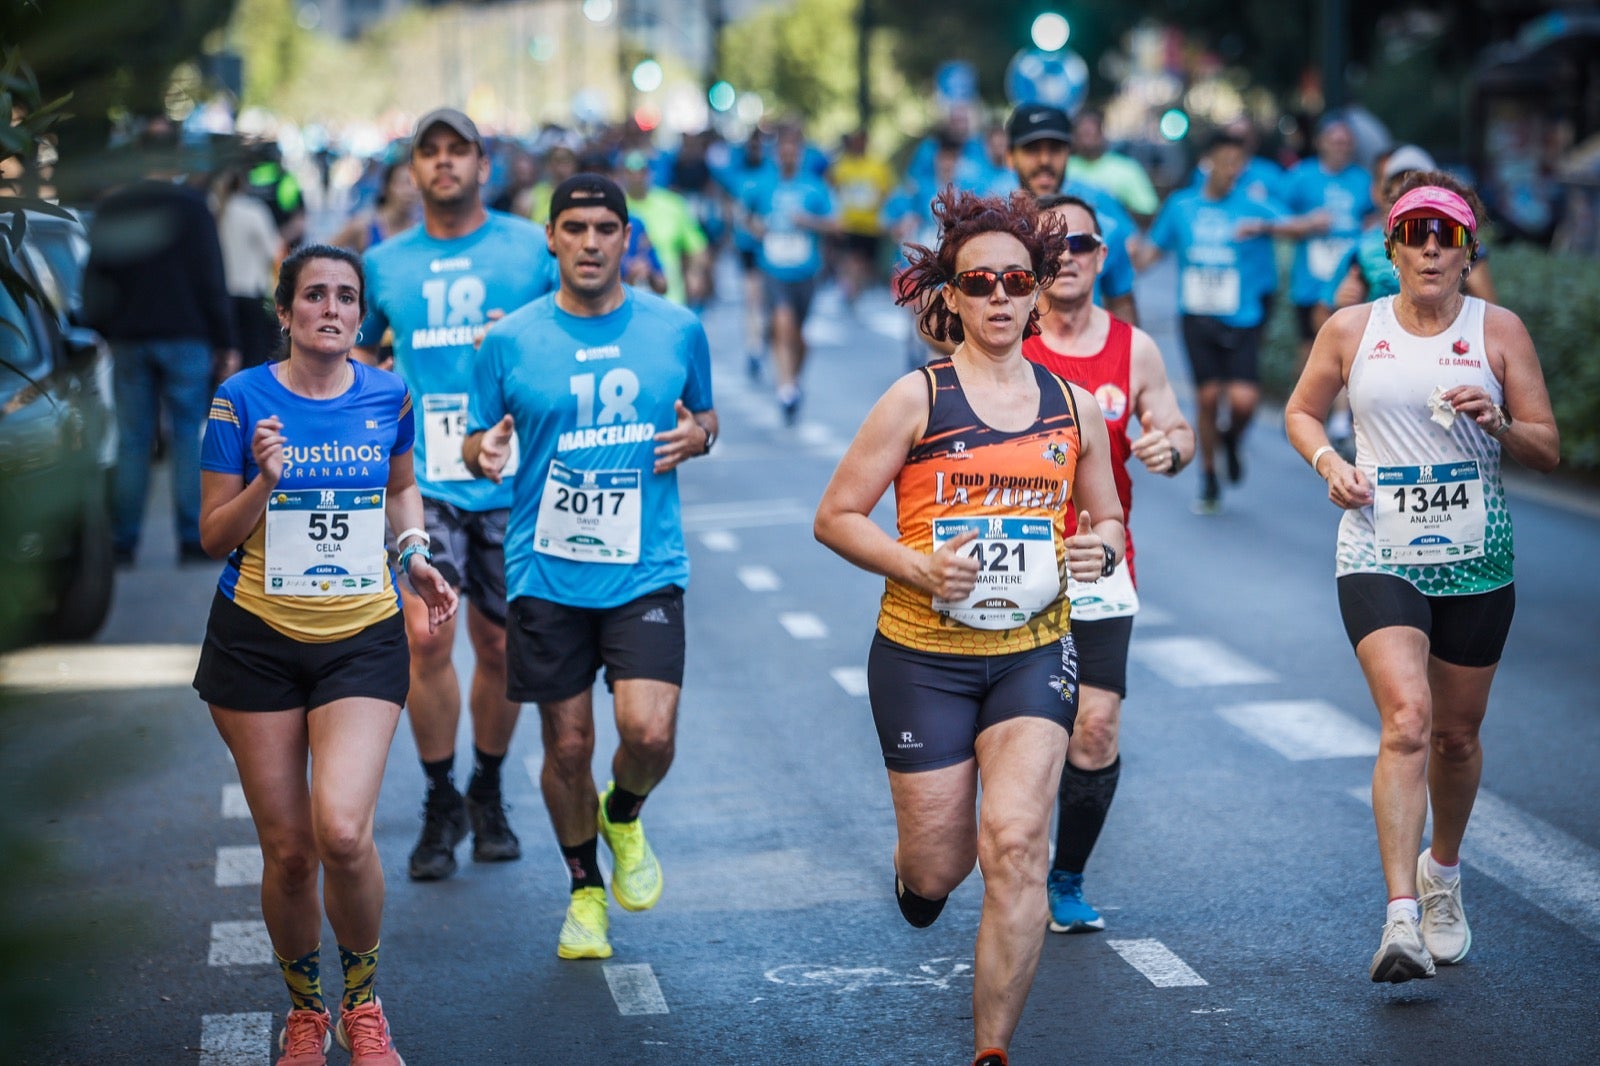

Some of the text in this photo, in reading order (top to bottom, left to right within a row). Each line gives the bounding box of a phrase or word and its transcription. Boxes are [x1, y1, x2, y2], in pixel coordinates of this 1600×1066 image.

[422, 276, 486, 327] 18
[1452, 359, 1481, 369] GARNATA
[570, 367, 639, 428] 18
[557, 422, 656, 453] MARCELINO
[282, 440, 382, 470] gustinos
[283, 466, 369, 479] GRANADA
[950, 472, 1059, 492] Club Deportivo
[1419, 466, 1433, 479] 18
[320, 491, 335, 505] 18
[935, 471, 969, 506] LA
[1393, 483, 1470, 513] 1344
[554, 487, 625, 516] 2017
[308, 513, 349, 541] 55
[577, 517, 599, 526] DAVID
[988, 519, 1003, 532] 18
[1410, 514, 1452, 524] ANA JULIA
[316, 544, 342, 552] CELIA
[967, 543, 1025, 572] 421
[976, 575, 1023, 585] MARI TERE
